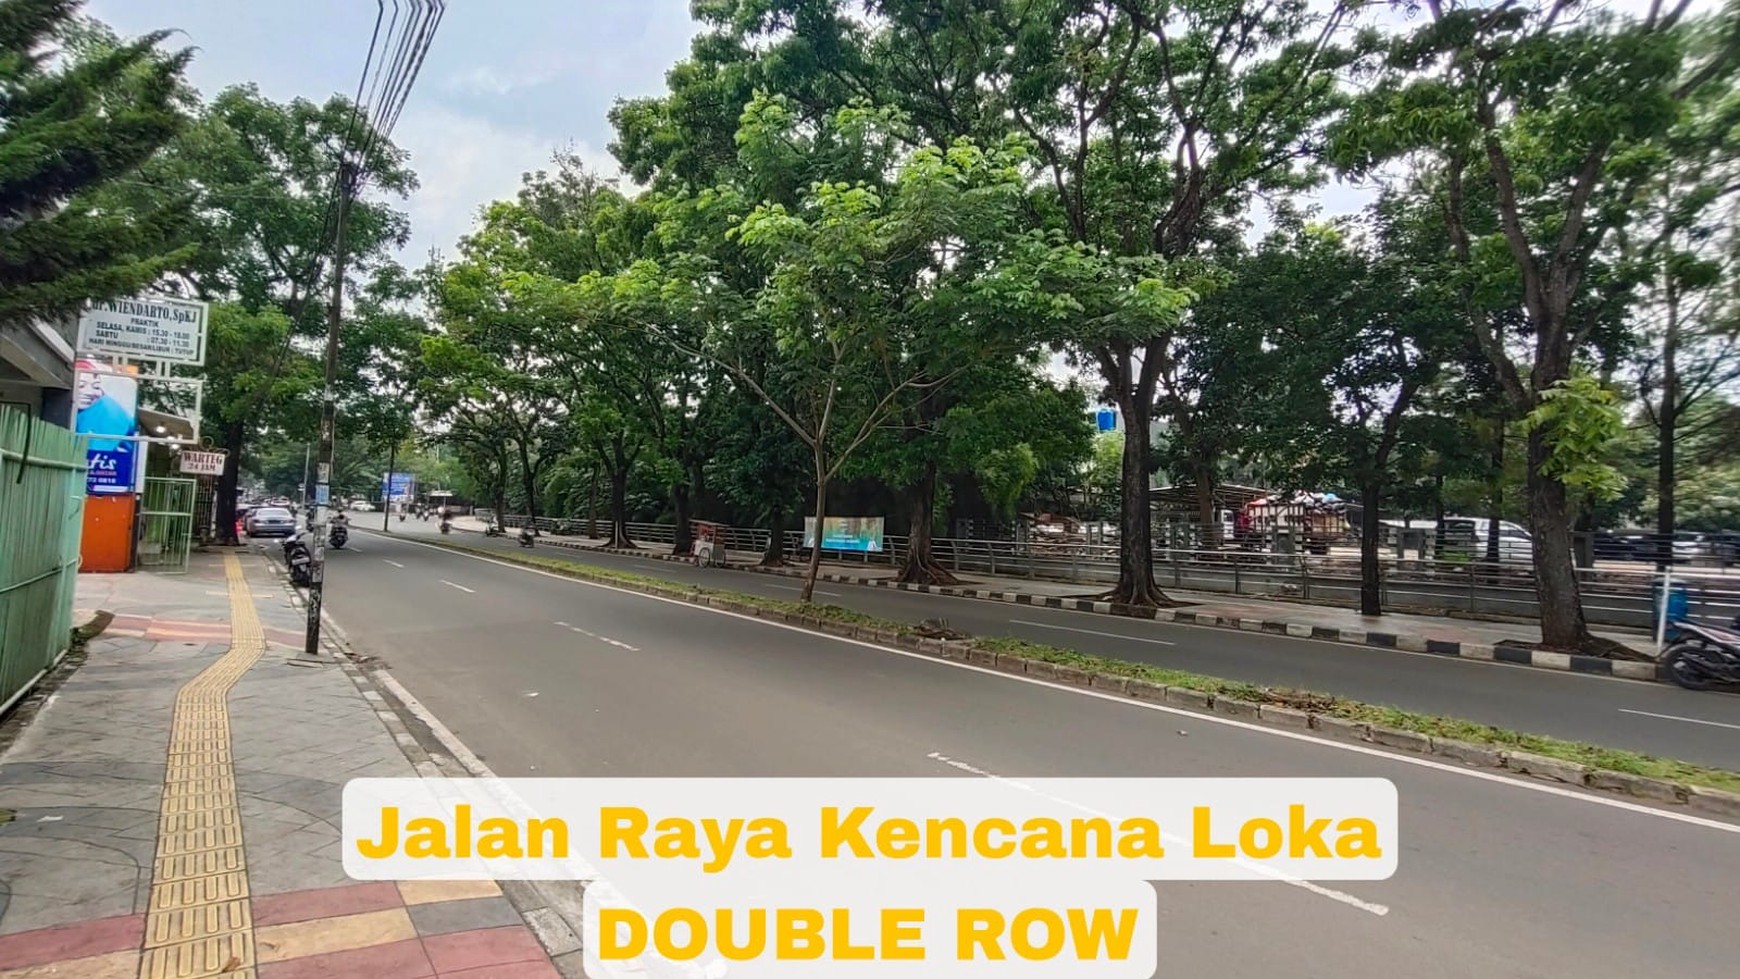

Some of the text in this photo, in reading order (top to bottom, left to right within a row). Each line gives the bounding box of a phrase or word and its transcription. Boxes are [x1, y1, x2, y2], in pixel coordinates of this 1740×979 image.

[131, 318, 159, 327] PRAKTIK
[96, 330, 119, 339] SABTU
[126, 326, 147, 334] KAMIS
[184, 452, 223, 465] WARTEG
